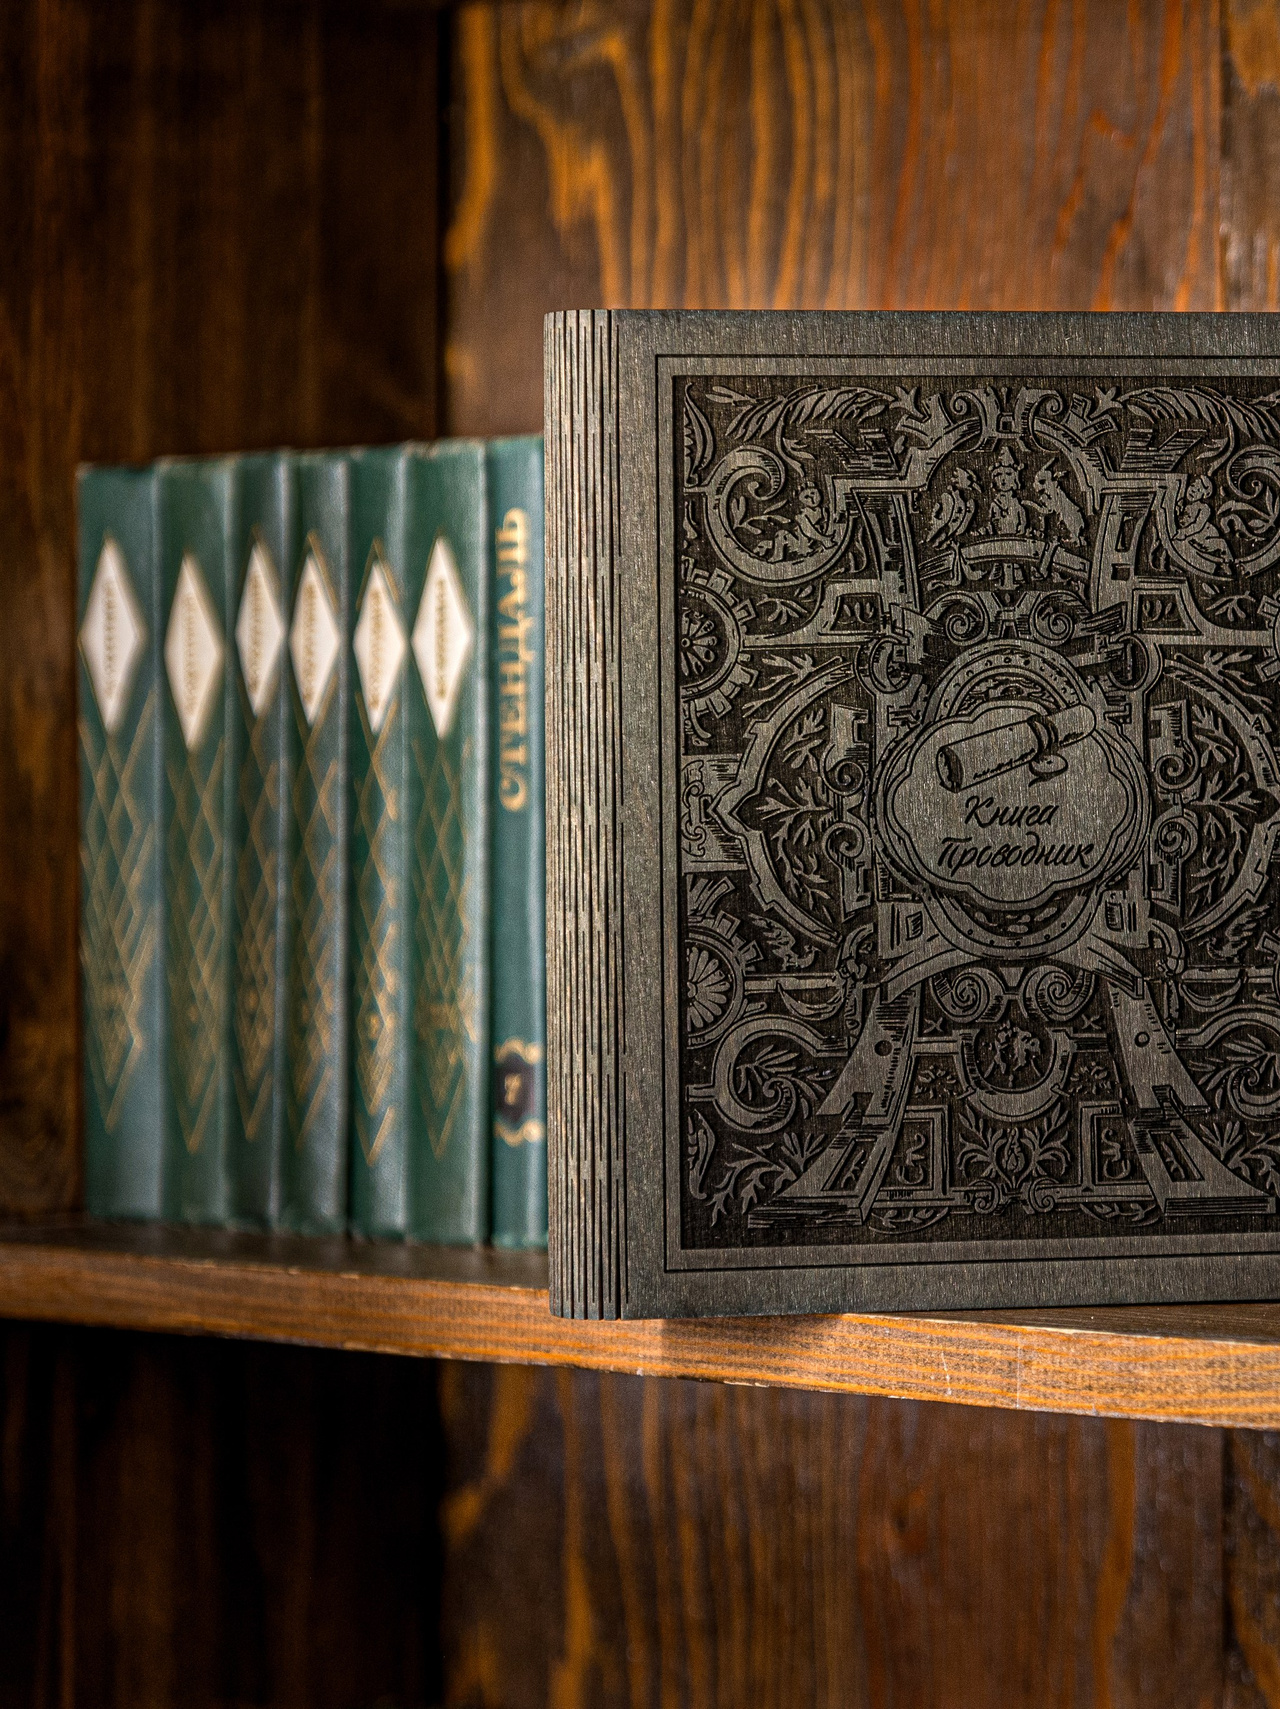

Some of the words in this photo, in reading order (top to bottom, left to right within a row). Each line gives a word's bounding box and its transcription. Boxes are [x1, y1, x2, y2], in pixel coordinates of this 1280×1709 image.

[495, 507, 535, 813] СТЕНДАЛЬ
[964, 795, 1060, 829] Книга
[937, 831, 1095, 877] Проводник
